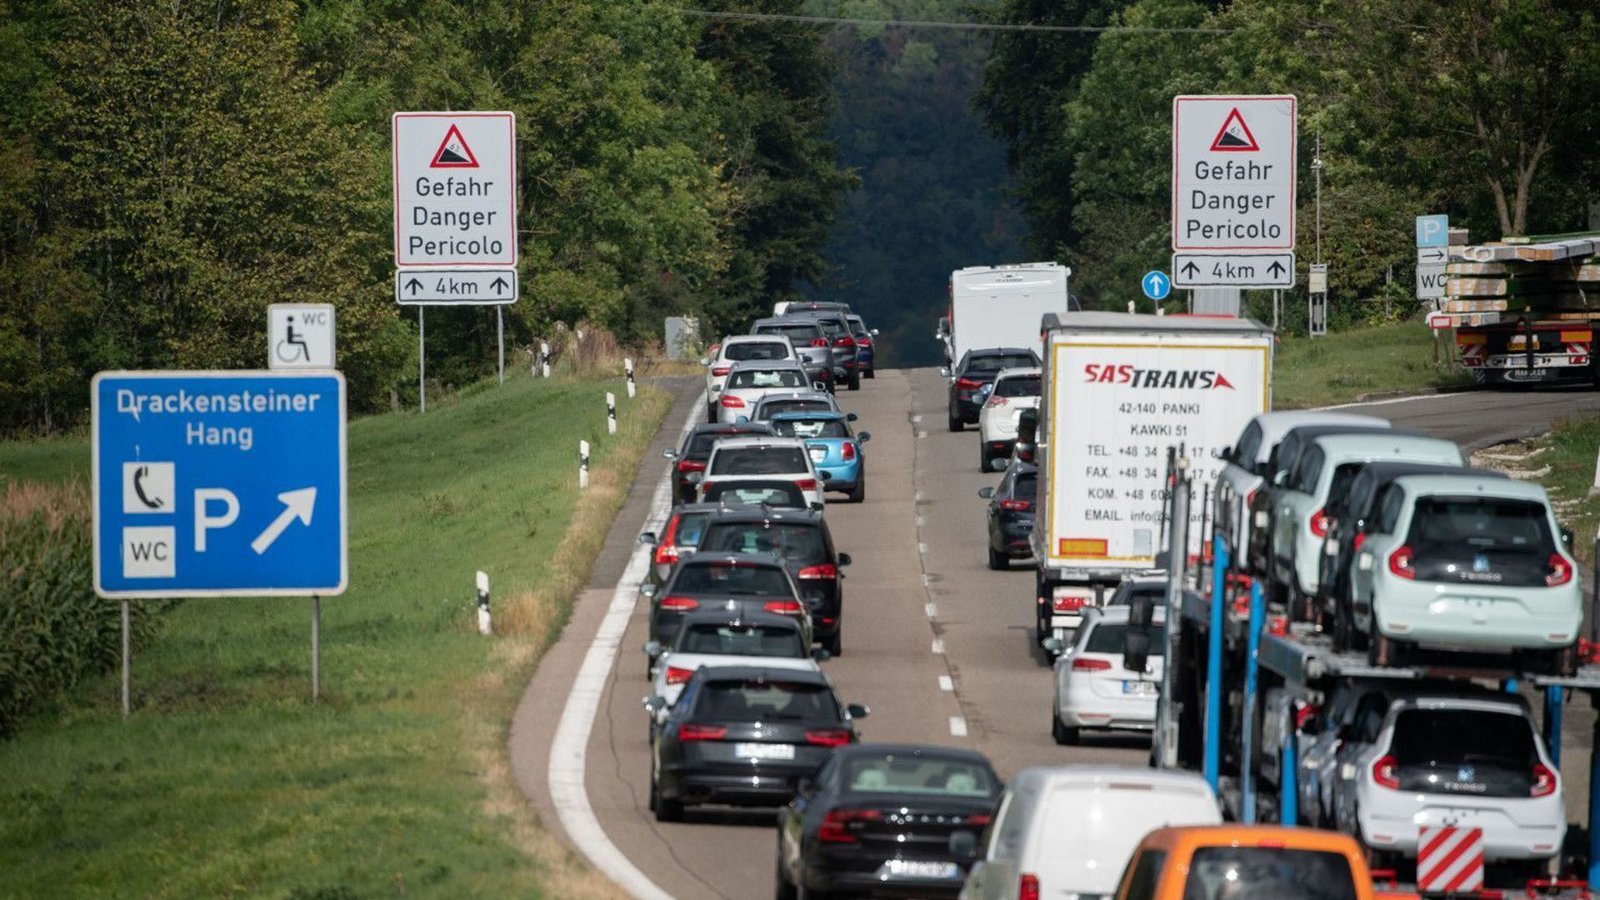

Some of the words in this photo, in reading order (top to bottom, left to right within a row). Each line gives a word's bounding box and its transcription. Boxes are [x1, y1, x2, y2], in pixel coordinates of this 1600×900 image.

[1195, 161, 1273, 180] Gefahr
[416, 177, 493, 197] Gefahr
[1192, 190, 1276, 215] Danger
[413, 206, 497, 231] Danger
[1187, 219, 1281, 239] Pericolo
[1424, 219, 1441, 243] P
[409, 235, 503, 256] Pericolo
[1421, 273, 1447, 288] WC
[302, 312, 326, 326] WC
[1084, 363, 1215, 389] SASTRANS
[117, 388, 320, 413] Drackensteiner
[1119, 402, 1156, 415] 42-140
[1162, 403, 1200, 415] PANKI
[186, 422, 252, 450] Hang
[1130, 424, 1172, 437] KAWKI
[1175, 425, 1188, 437] 51
[1086, 444, 1111, 457] TEL.
[1119, 446, 1138, 458] +48
[1144, 447, 1158, 458] 34
[1192, 447, 1204, 459] 17
[1085, 466, 1110, 478] FAX.
[1119, 467, 1138, 479] +48
[1144, 468, 1158, 479] 34
[1192, 469, 1204, 480] 17
[1087, 488, 1118, 500] KOM.
[1124, 489, 1144, 501] +48
[194, 488, 241, 553] P
[1084, 509, 1124, 522] EMAIL.
[130, 541, 168, 561] WC
